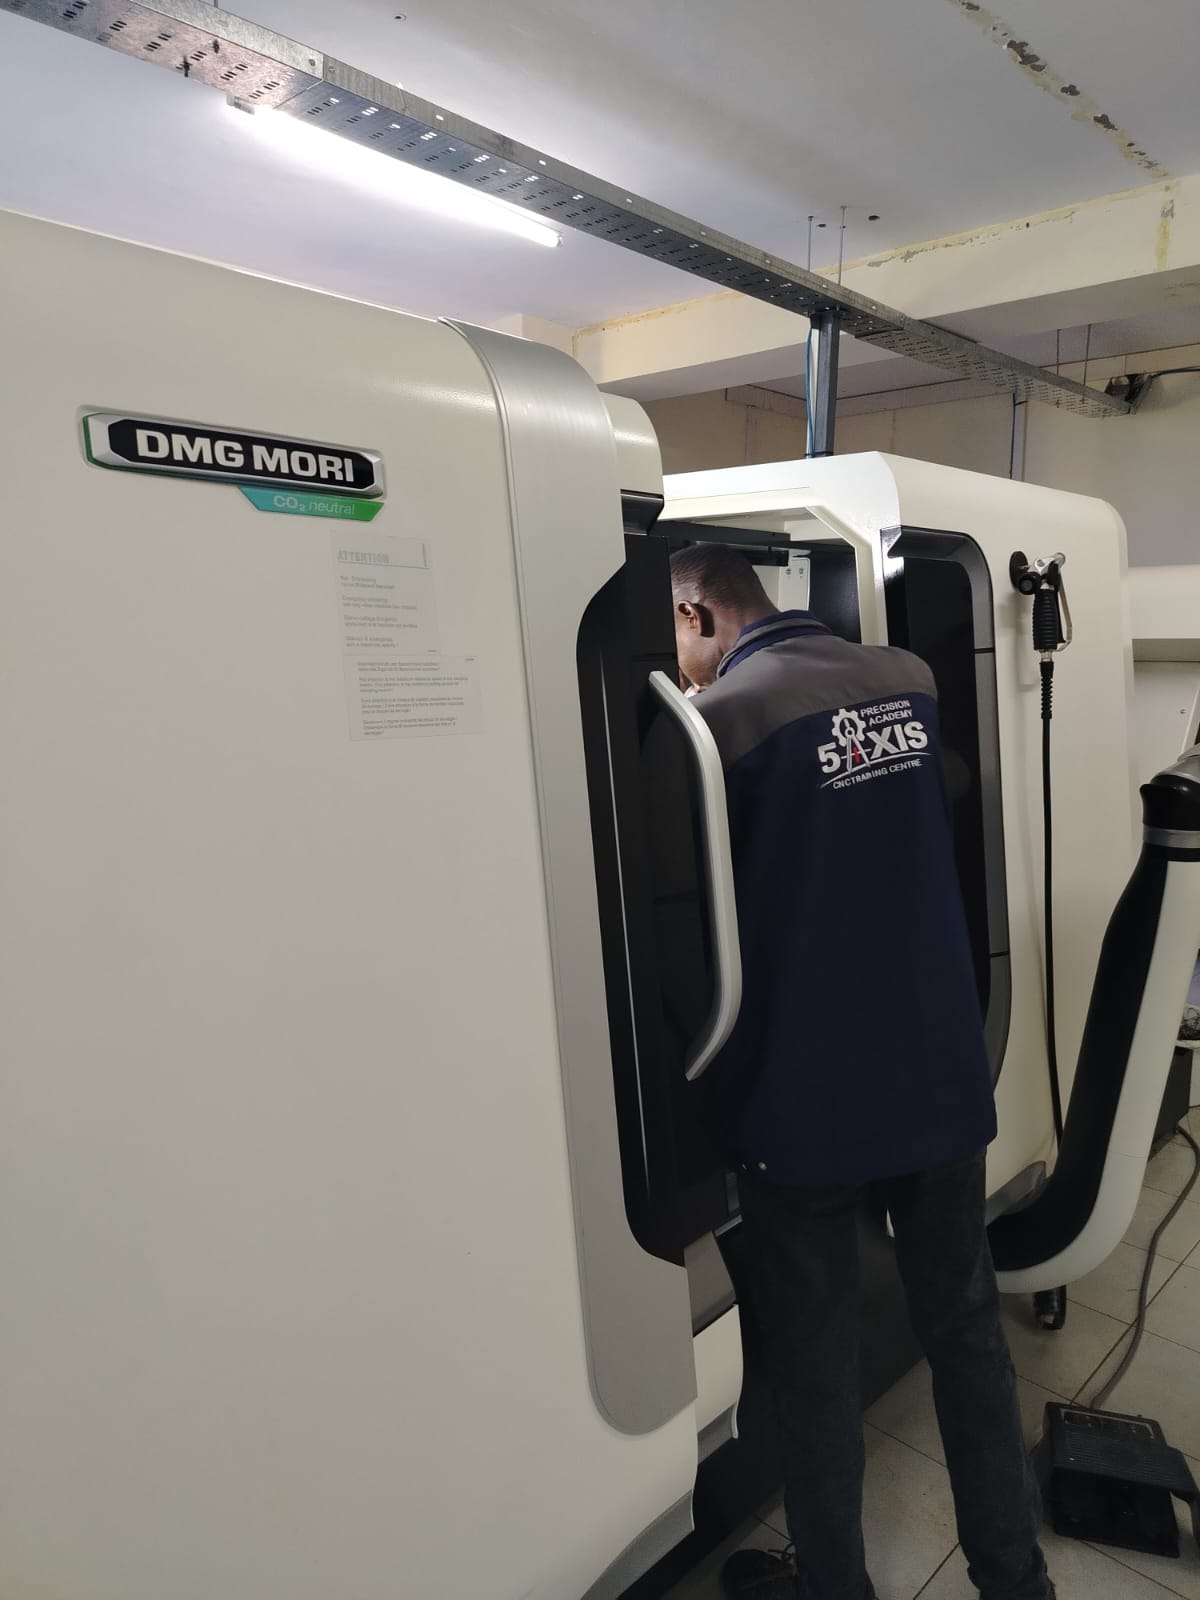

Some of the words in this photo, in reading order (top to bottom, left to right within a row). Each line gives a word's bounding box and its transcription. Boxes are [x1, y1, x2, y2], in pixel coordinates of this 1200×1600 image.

[135, 429, 244, 467] DMG
[252, 444, 354, 482] MORI
[309, 499, 355, 515] neutral
[860, 699, 911, 718] PRECISION
[868, 709, 913, 727] ACADEMY
[888, 758, 923, 773] CENTRE
